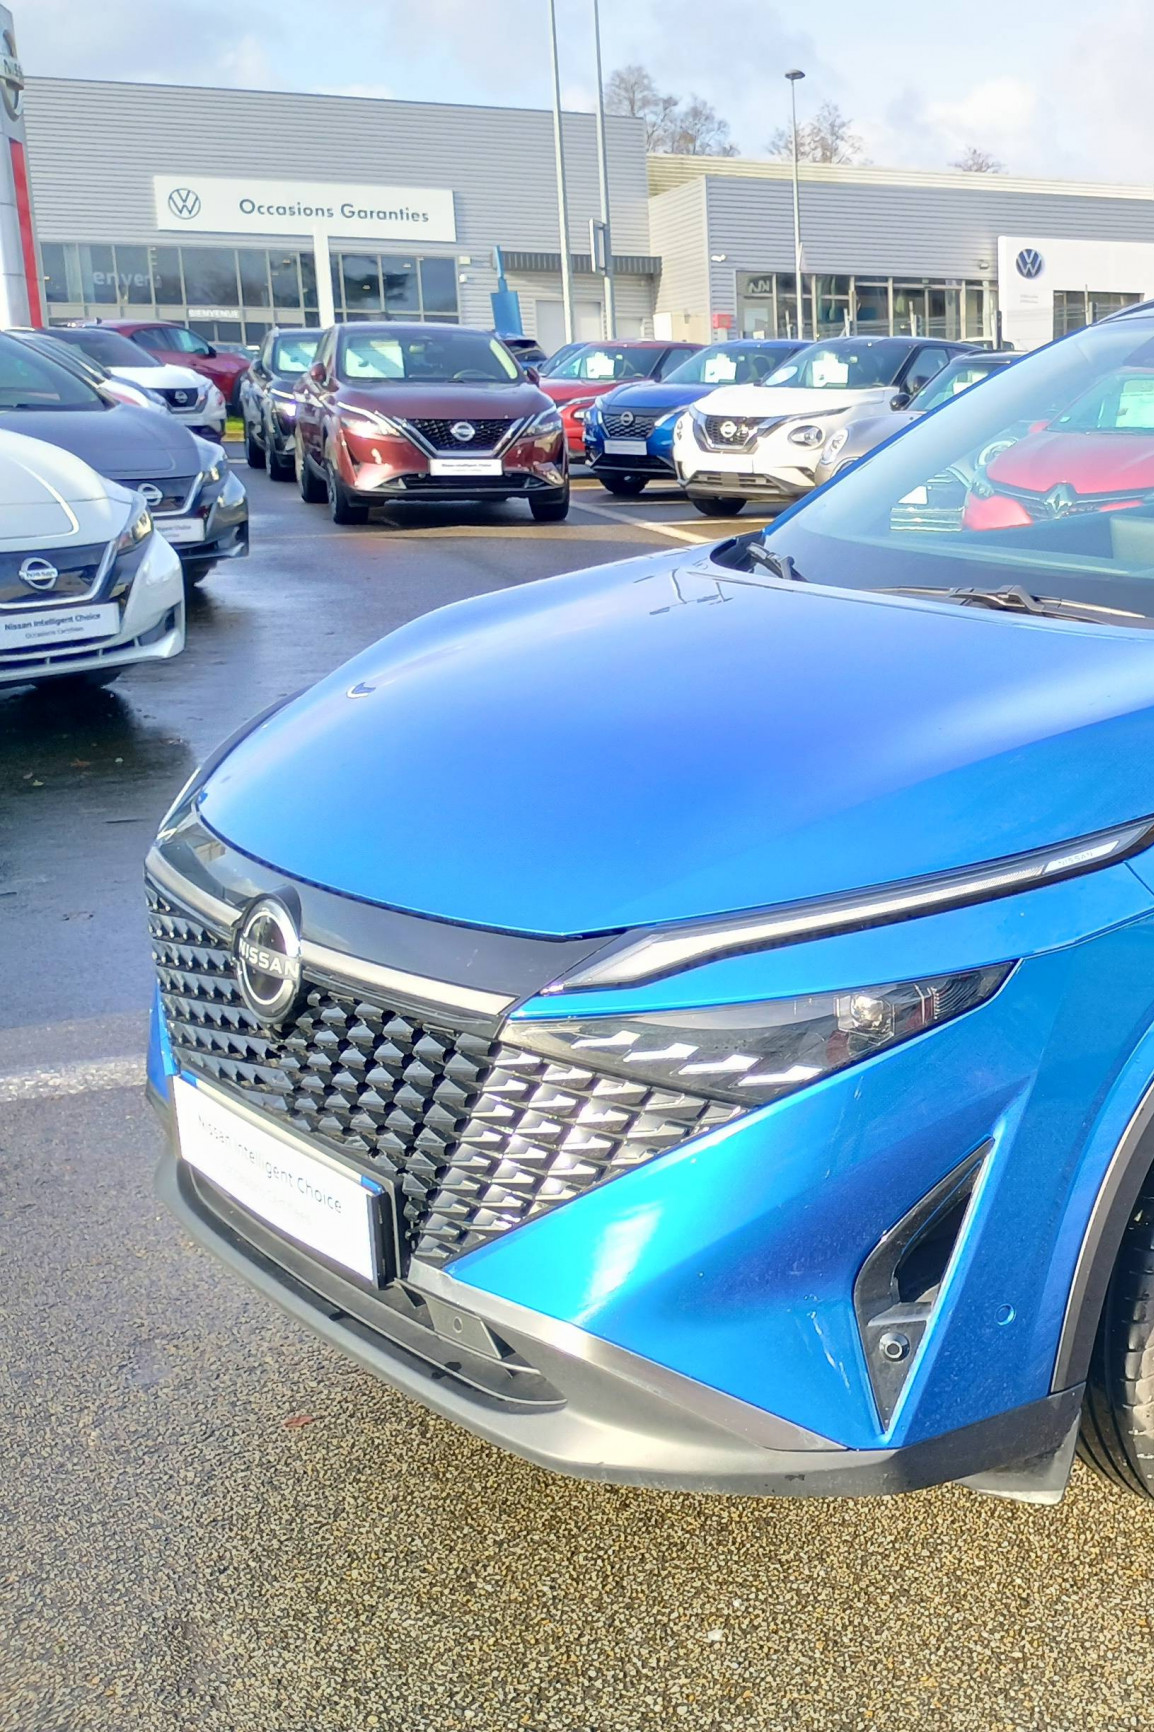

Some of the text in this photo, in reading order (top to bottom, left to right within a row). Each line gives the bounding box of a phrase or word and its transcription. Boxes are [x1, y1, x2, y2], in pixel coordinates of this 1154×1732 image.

[239, 199, 429, 222] Occasions Garanties
[4, 611, 101, 631] Nissan Intelligent Choice
[239, 938, 300, 980] NISSAN
[197, 1112, 231, 1145] Nissan
[233, 1138, 294, 1188] Intelligent
[296, 1176, 342, 1214] Choice
